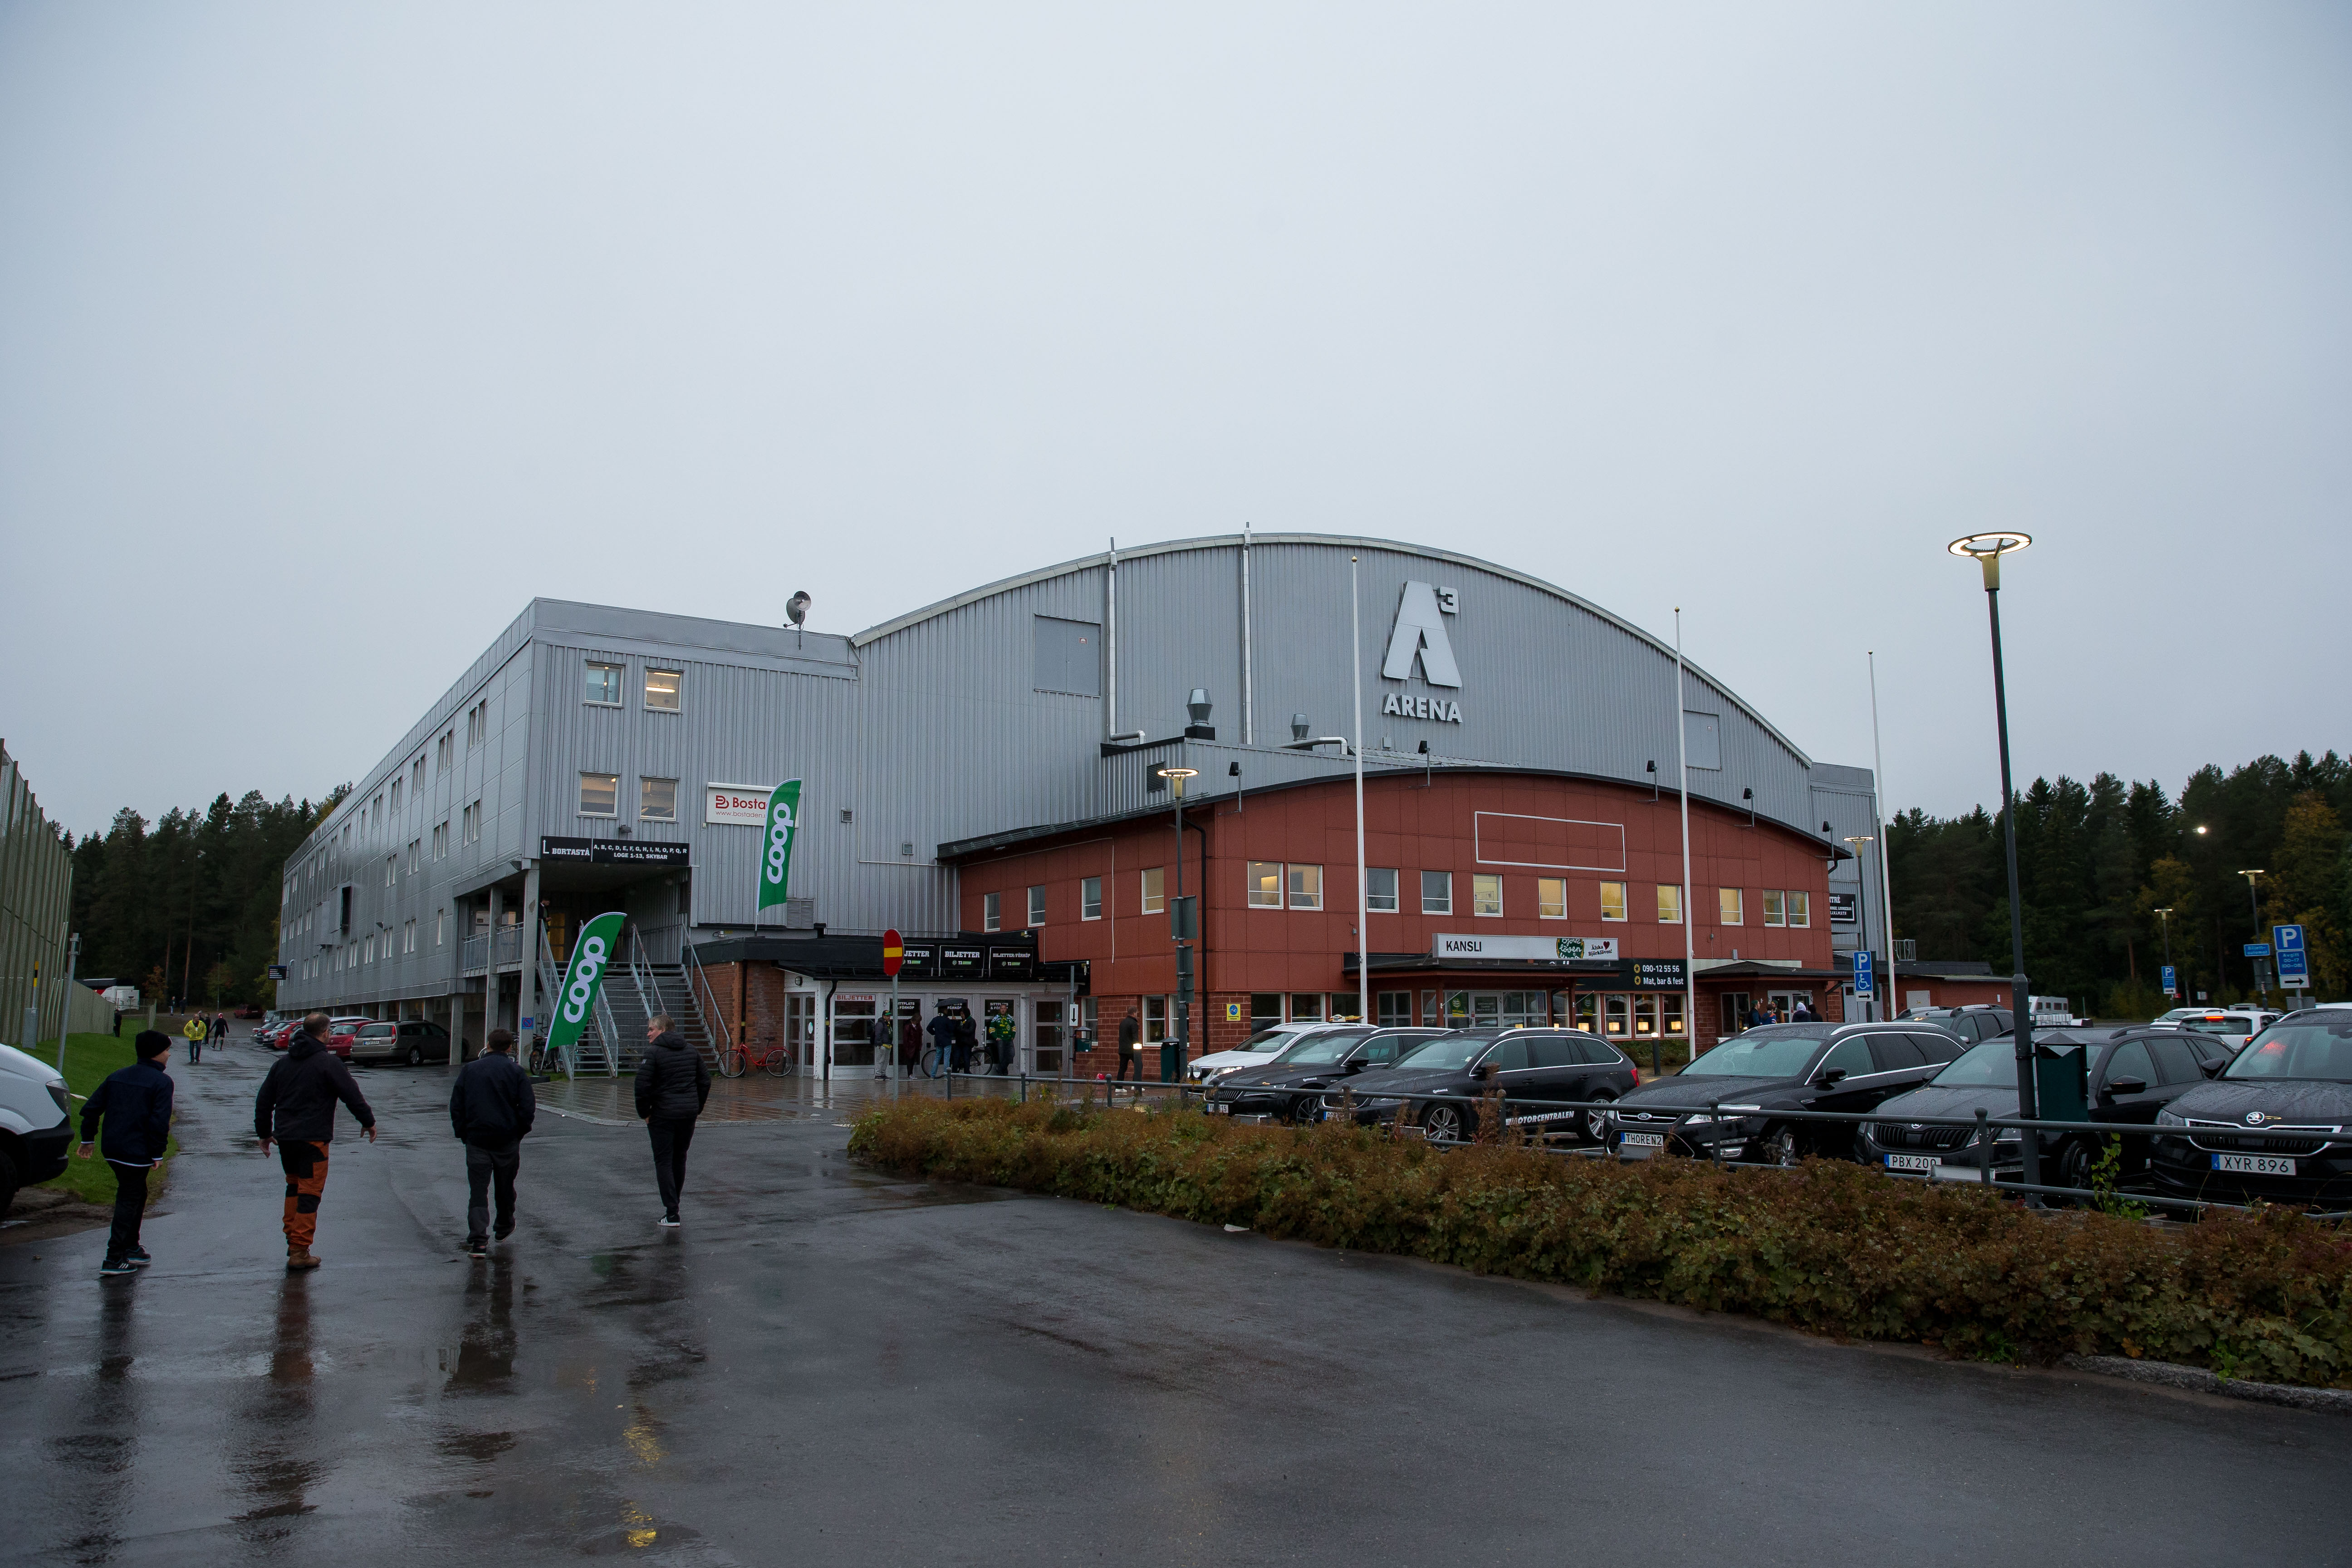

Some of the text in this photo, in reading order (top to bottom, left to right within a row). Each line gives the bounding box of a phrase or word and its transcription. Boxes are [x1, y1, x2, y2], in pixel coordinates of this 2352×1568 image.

[1383, 693, 1463, 723] ARENA
[733, 797, 767, 810] Bosta
[767, 803, 794, 884] coop
[552, 848, 590, 856] BORTASTÅ
[2282, 928, 2297, 947] P
[1446, 941, 1481, 951] KANSLI
[1858, 954, 1868, 969] P
[2165, 968, 2172, 976] P
[564, 936, 607, 1023] coop
[1643, 977, 1656, 985] Mat,
[1626, 1134, 1661, 1145] THOREN2
[1892, 1156, 1936, 1168] PBX 200
[2224, 1156, 2288, 1172] XYR 896
